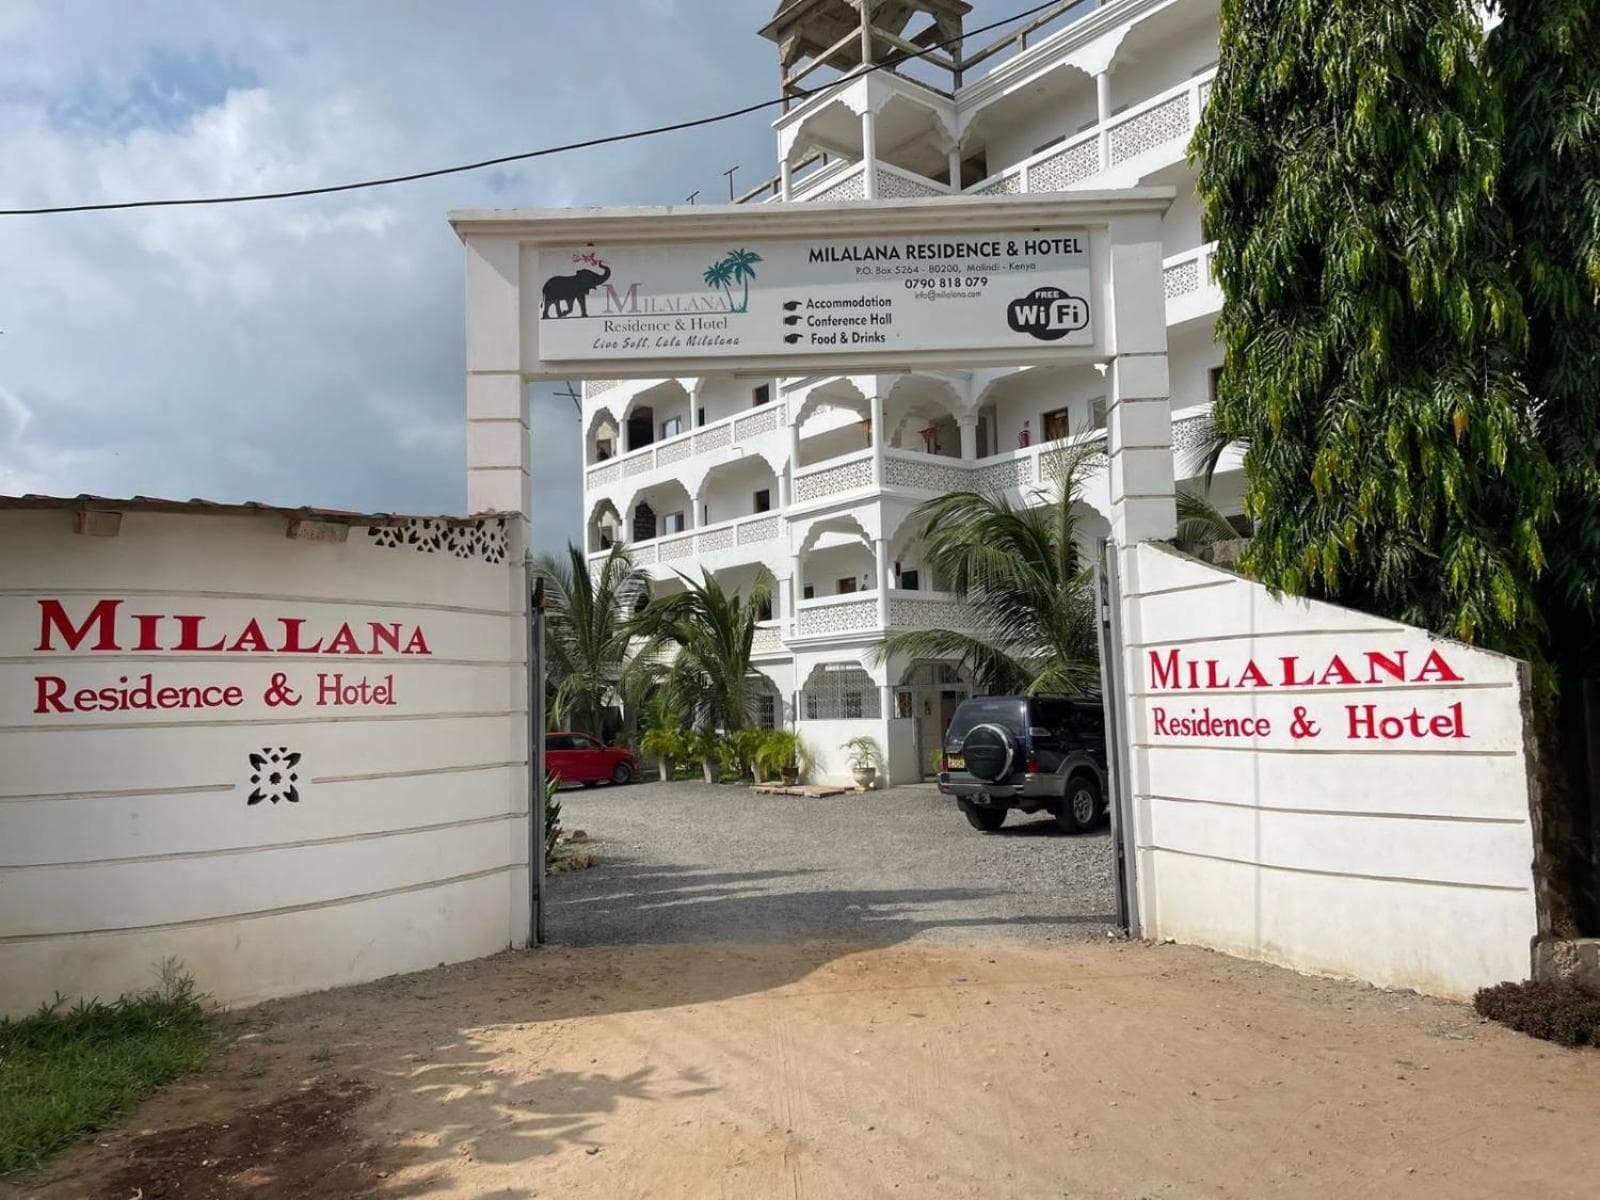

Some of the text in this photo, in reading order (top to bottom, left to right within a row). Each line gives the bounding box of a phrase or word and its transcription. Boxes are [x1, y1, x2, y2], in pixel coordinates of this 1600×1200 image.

[808, 239, 1082, 262] MILALANA RESIDENCE & HOTEL
[876, 266, 892, 275] Box
[895, 265, 919, 275] 5264
[967, 262, 1000, 272] Malindi
[1009, 262, 1036, 272] Kenya
[904, 276, 988, 289] 0790 818 079
[1035, 291, 1060, 299] FREE
[806, 296, 892, 309] Accommodation
[604, 317, 728, 333] Residence & Hotel
[807, 313, 892, 327] Conference Hall
[686, 335, 739, 347] Milalana
[811, 331, 886, 345] Food & Drinks
[33, 599, 432, 656] MILALANA
[1149, 648, 1465, 689] MILALANA
[34, 672, 397, 714] Residence & Hotel
[1152, 701, 1471, 740] Residence & Hotel
